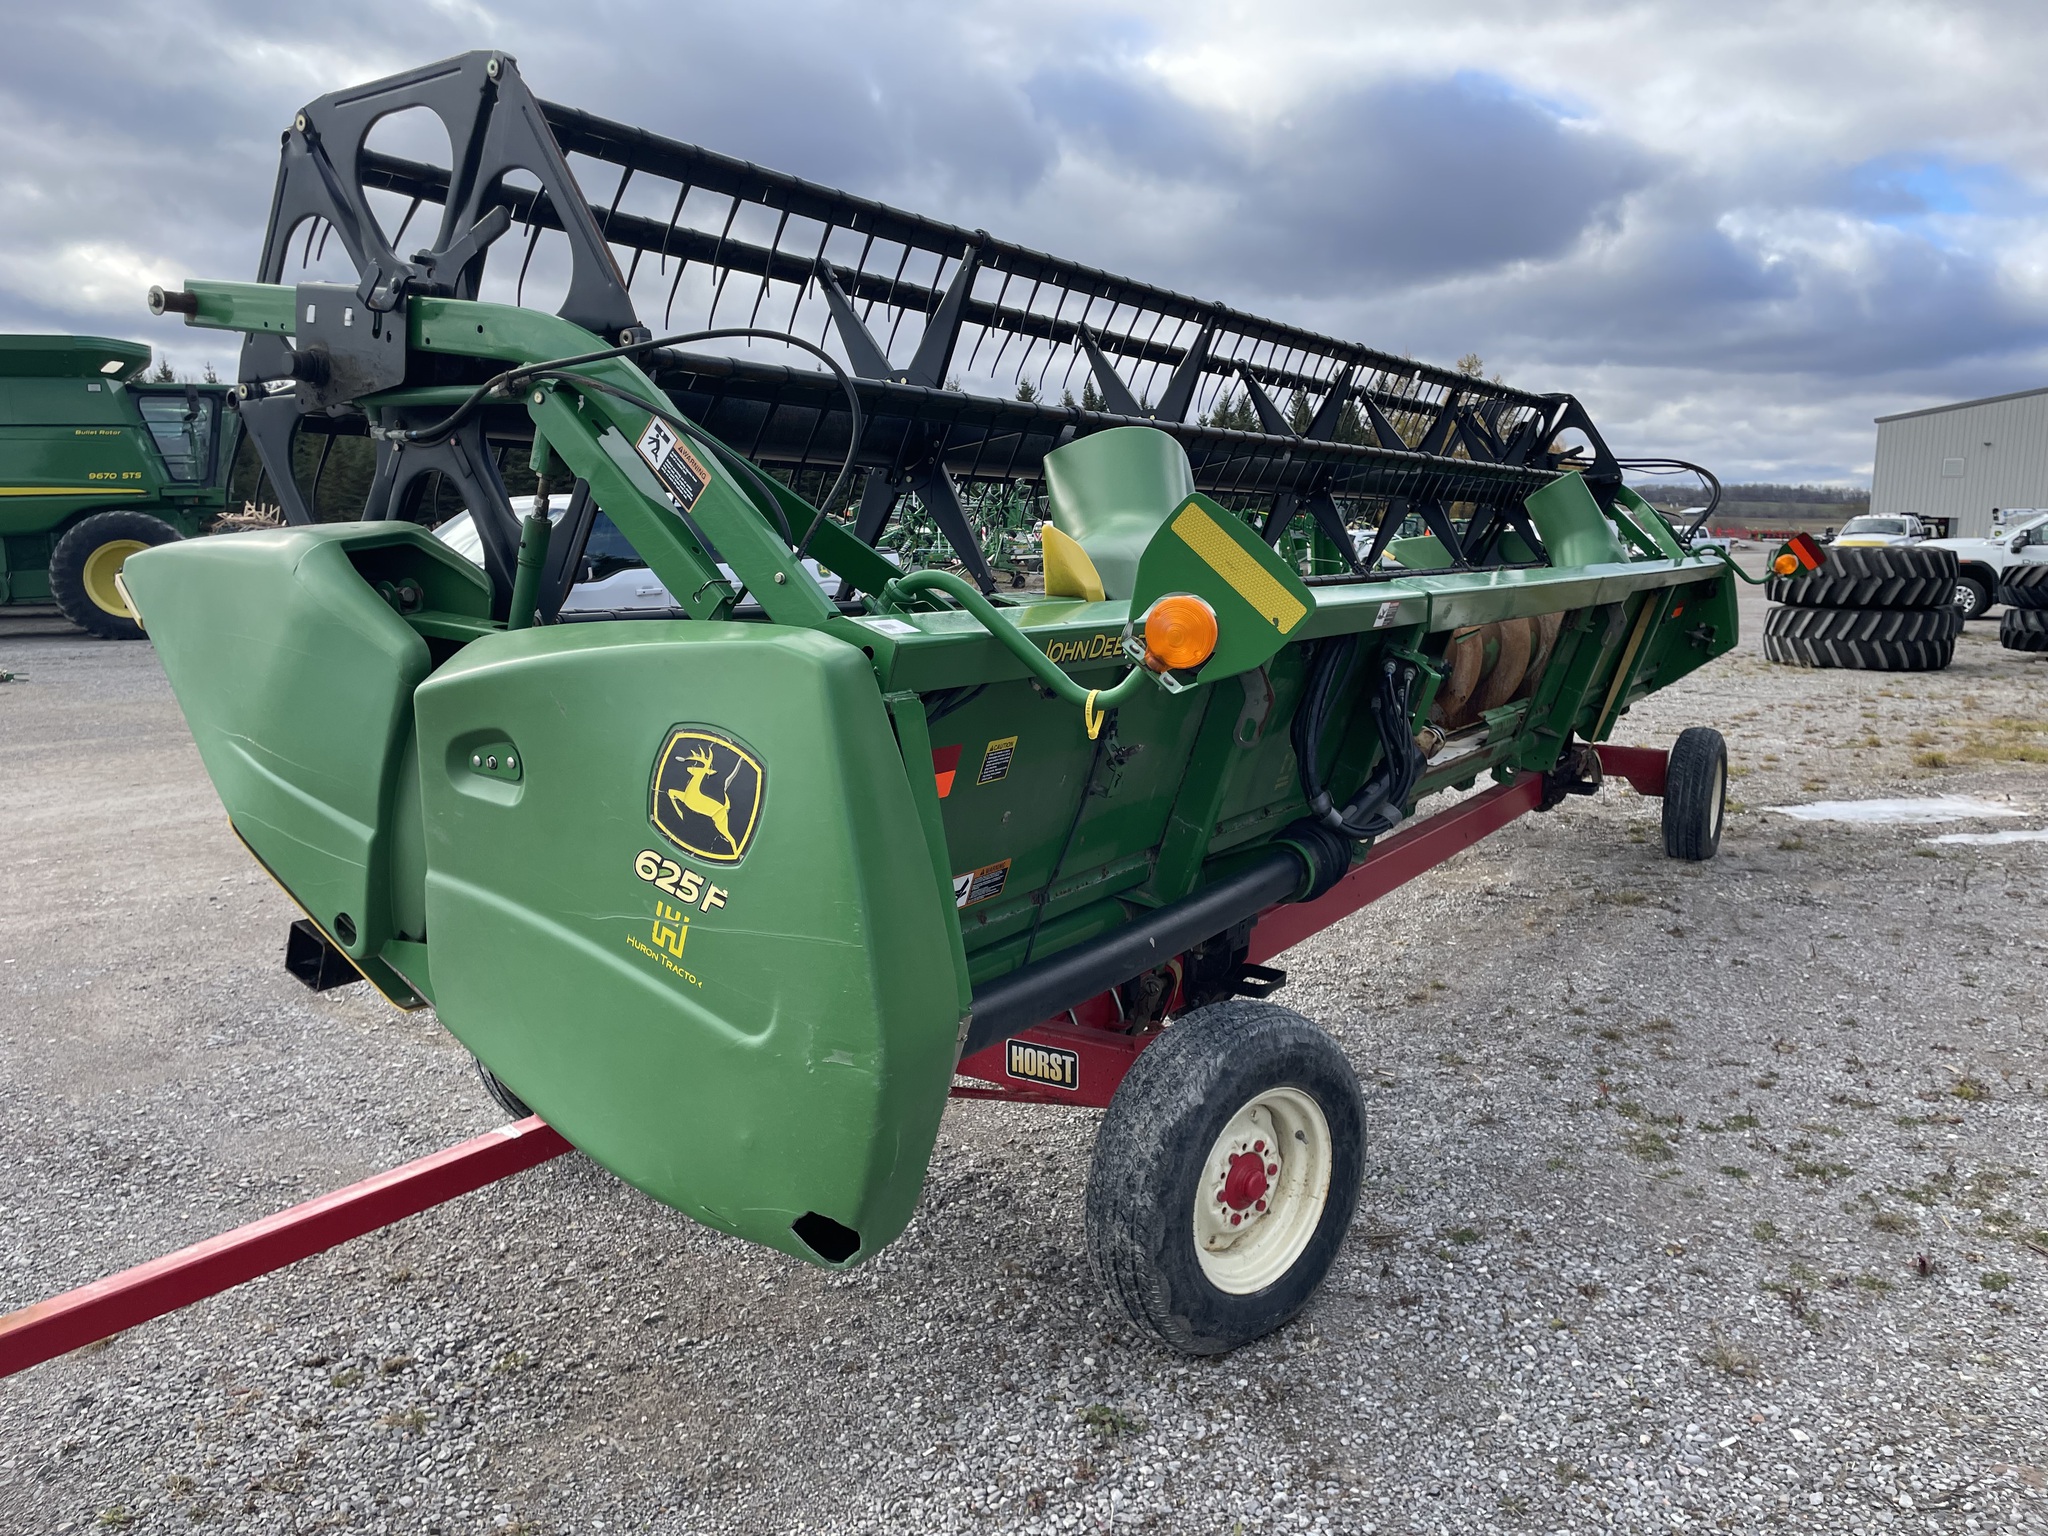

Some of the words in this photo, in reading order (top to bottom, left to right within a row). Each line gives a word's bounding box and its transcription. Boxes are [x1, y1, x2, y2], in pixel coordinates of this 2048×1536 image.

[88, 472, 117, 480] 9670
[122, 471, 142, 480] STS
[681, 449, 707, 481] WARNING
[993, 741, 1015, 751] CAUTION
[634, 849, 728, 914] 625F
[1011, 1045, 1075, 1084] HORST
